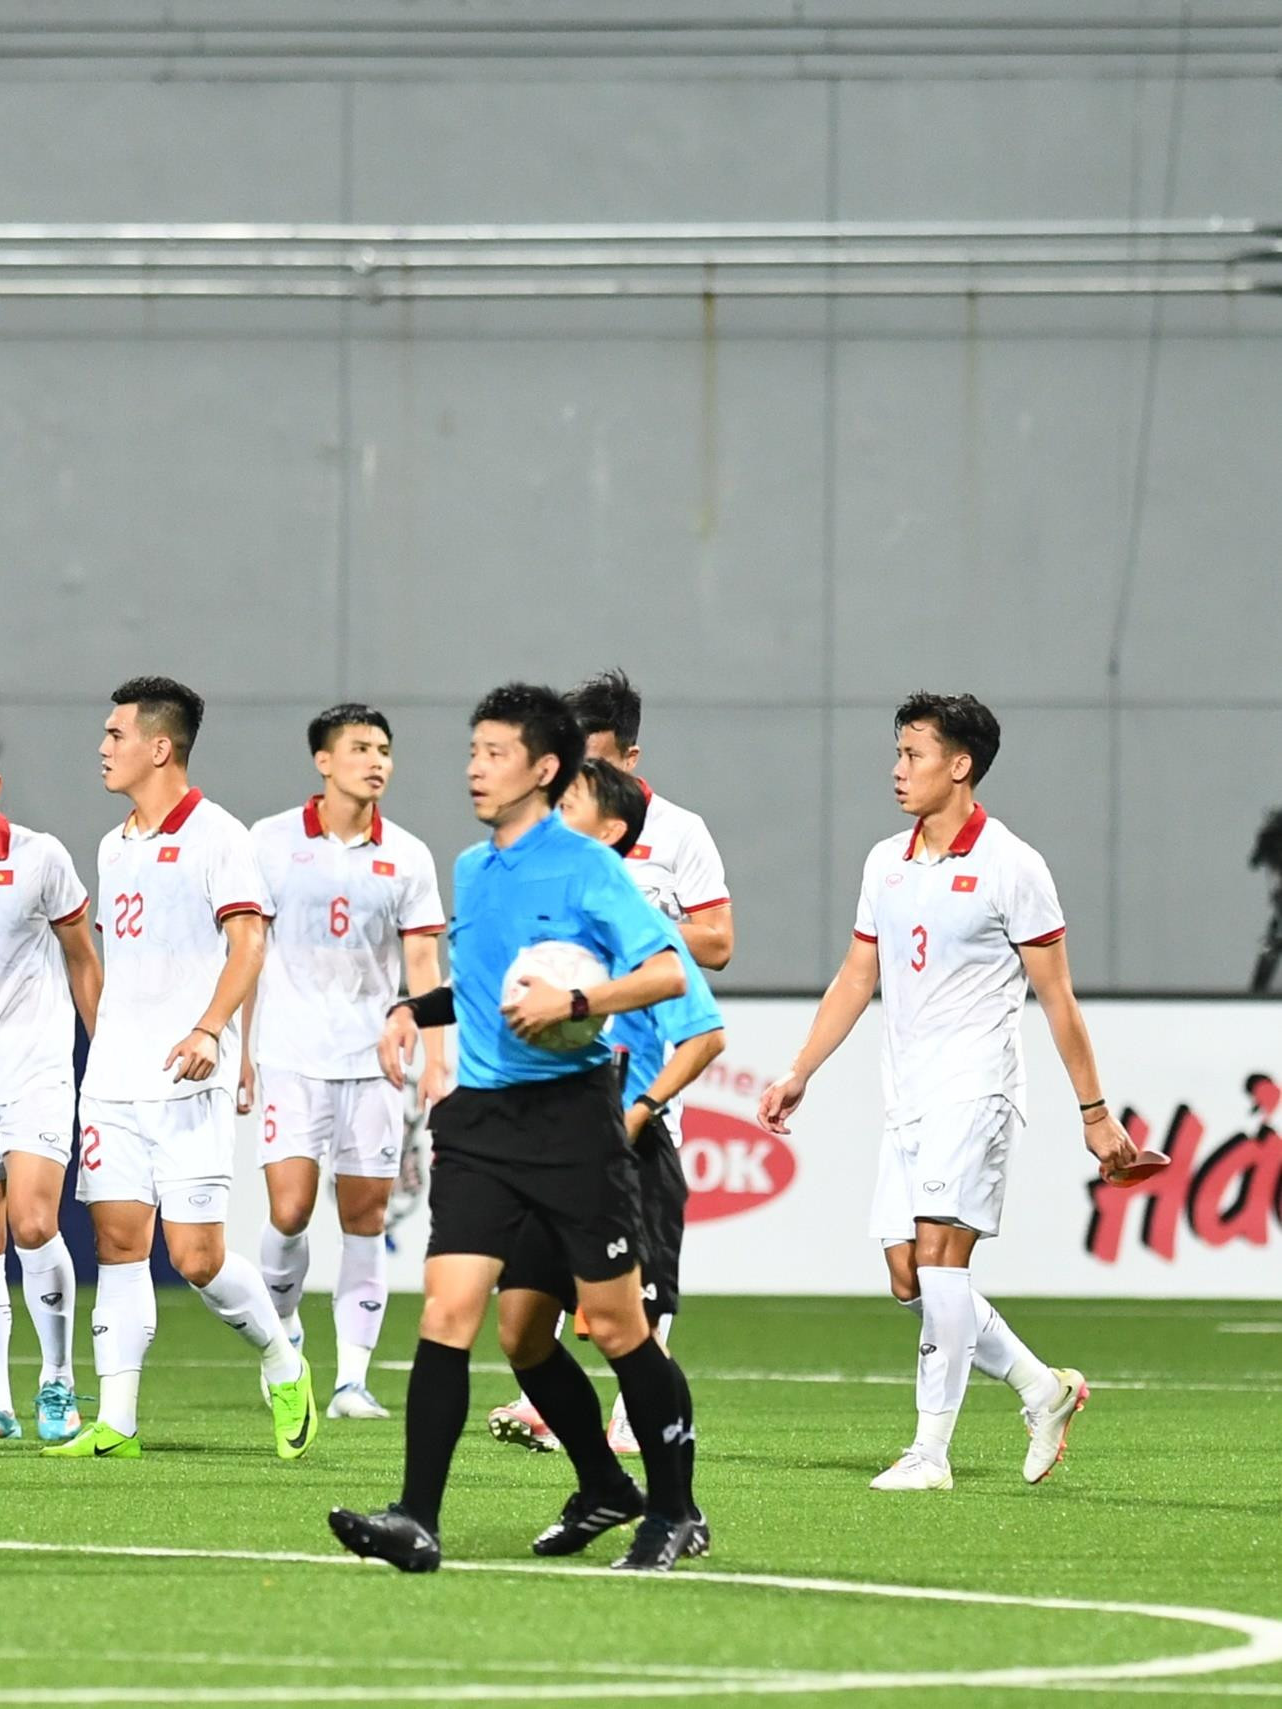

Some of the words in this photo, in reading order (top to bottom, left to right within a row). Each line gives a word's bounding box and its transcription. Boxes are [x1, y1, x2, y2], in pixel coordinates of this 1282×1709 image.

[114, 891, 143, 939] 22
[328, 896, 350, 938] 6
[911, 924, 928, 973] 3
[79, 1125, 102, 1171] 2
[264, 1104, 277, 1144] 6
[681, 1138, 775, 1194] OK
[1086, 1073, 1282, 1264] Hả
